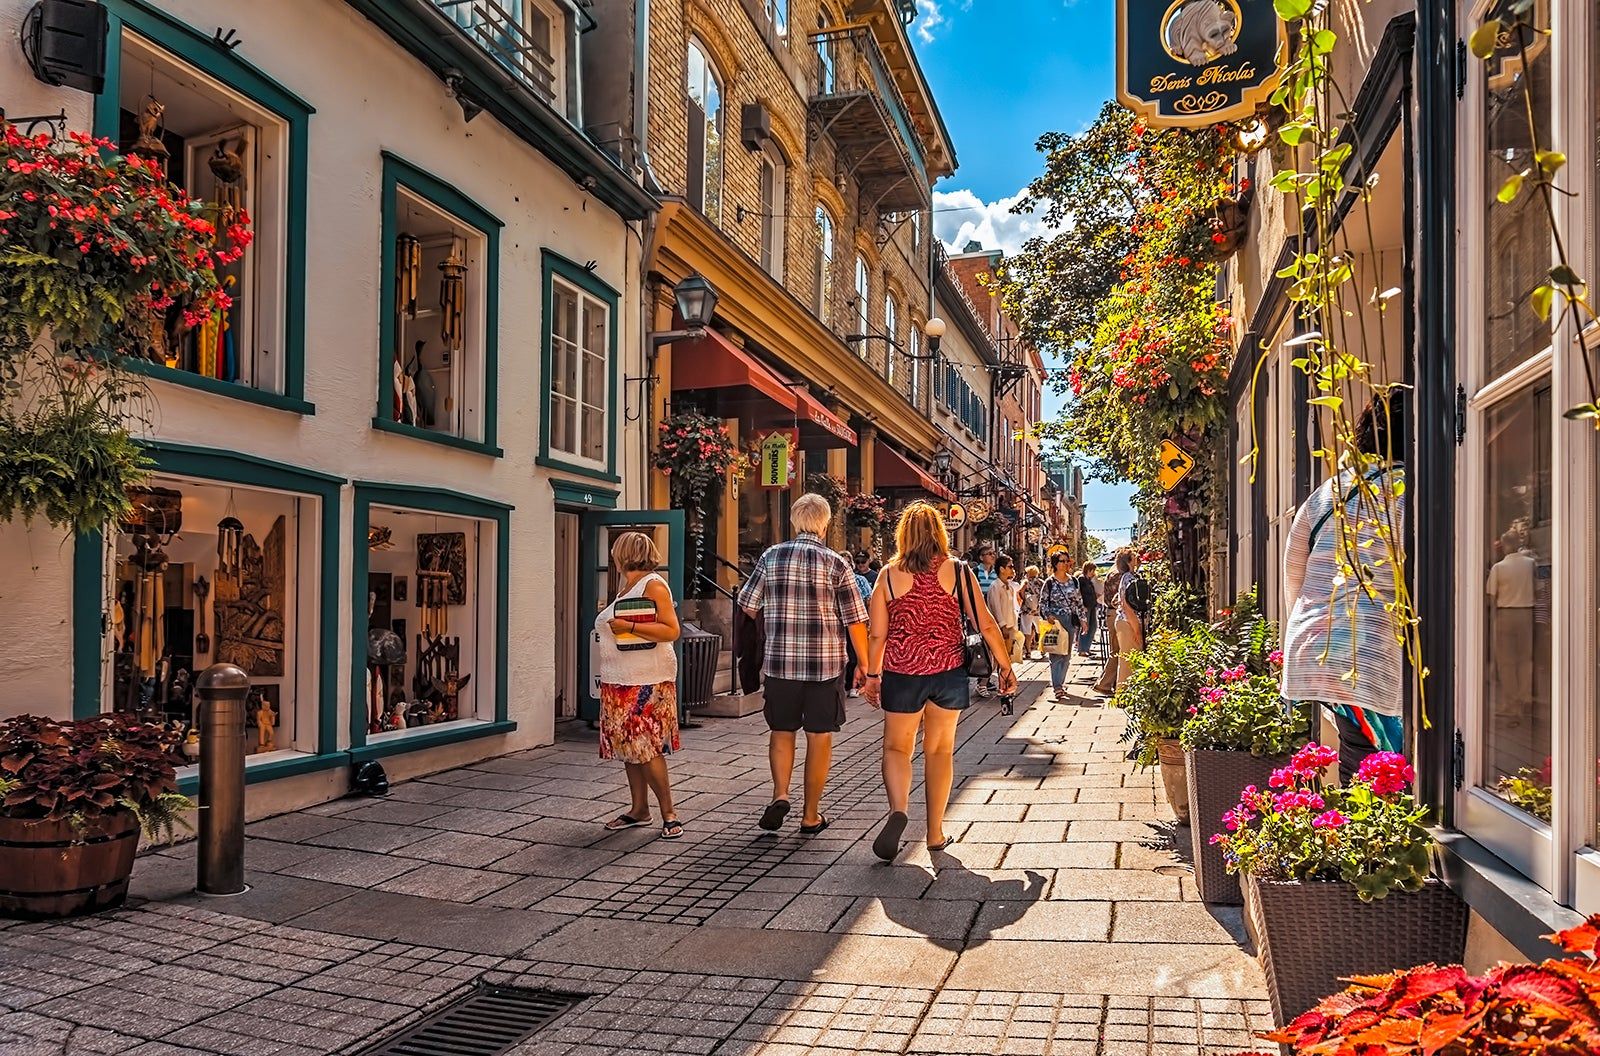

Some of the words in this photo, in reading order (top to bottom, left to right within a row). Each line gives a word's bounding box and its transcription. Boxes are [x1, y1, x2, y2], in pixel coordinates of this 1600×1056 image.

[1150, 73, 1193, 94] Denis
[1196, 61, 1256, 86] Nicolas
[584, 493, 593, 504] 49
